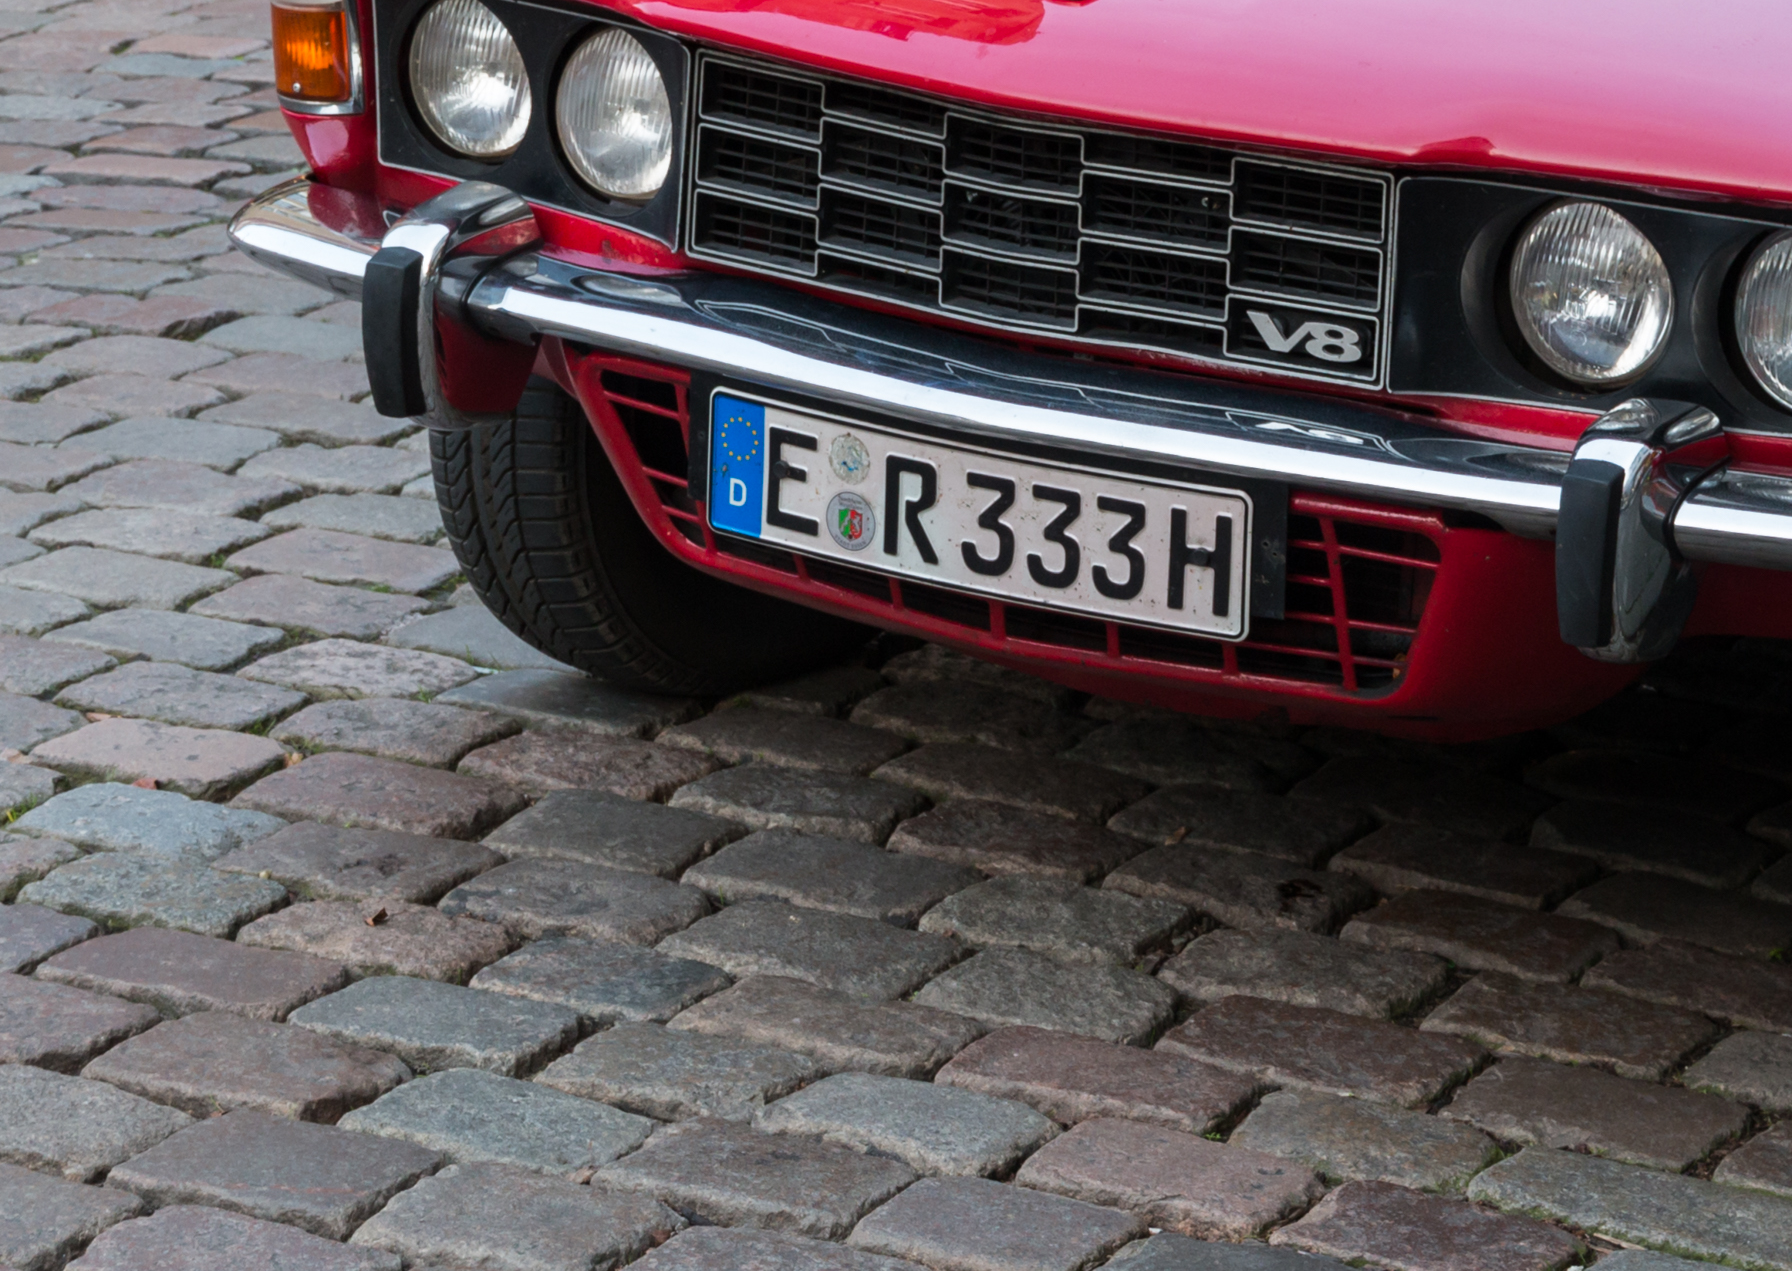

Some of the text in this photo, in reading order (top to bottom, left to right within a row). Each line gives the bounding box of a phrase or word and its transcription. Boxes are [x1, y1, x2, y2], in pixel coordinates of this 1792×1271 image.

[1247, 310, 1362, 363] V8
[729, 478, 747, 507] D
[767, 426, 819, 538] E
